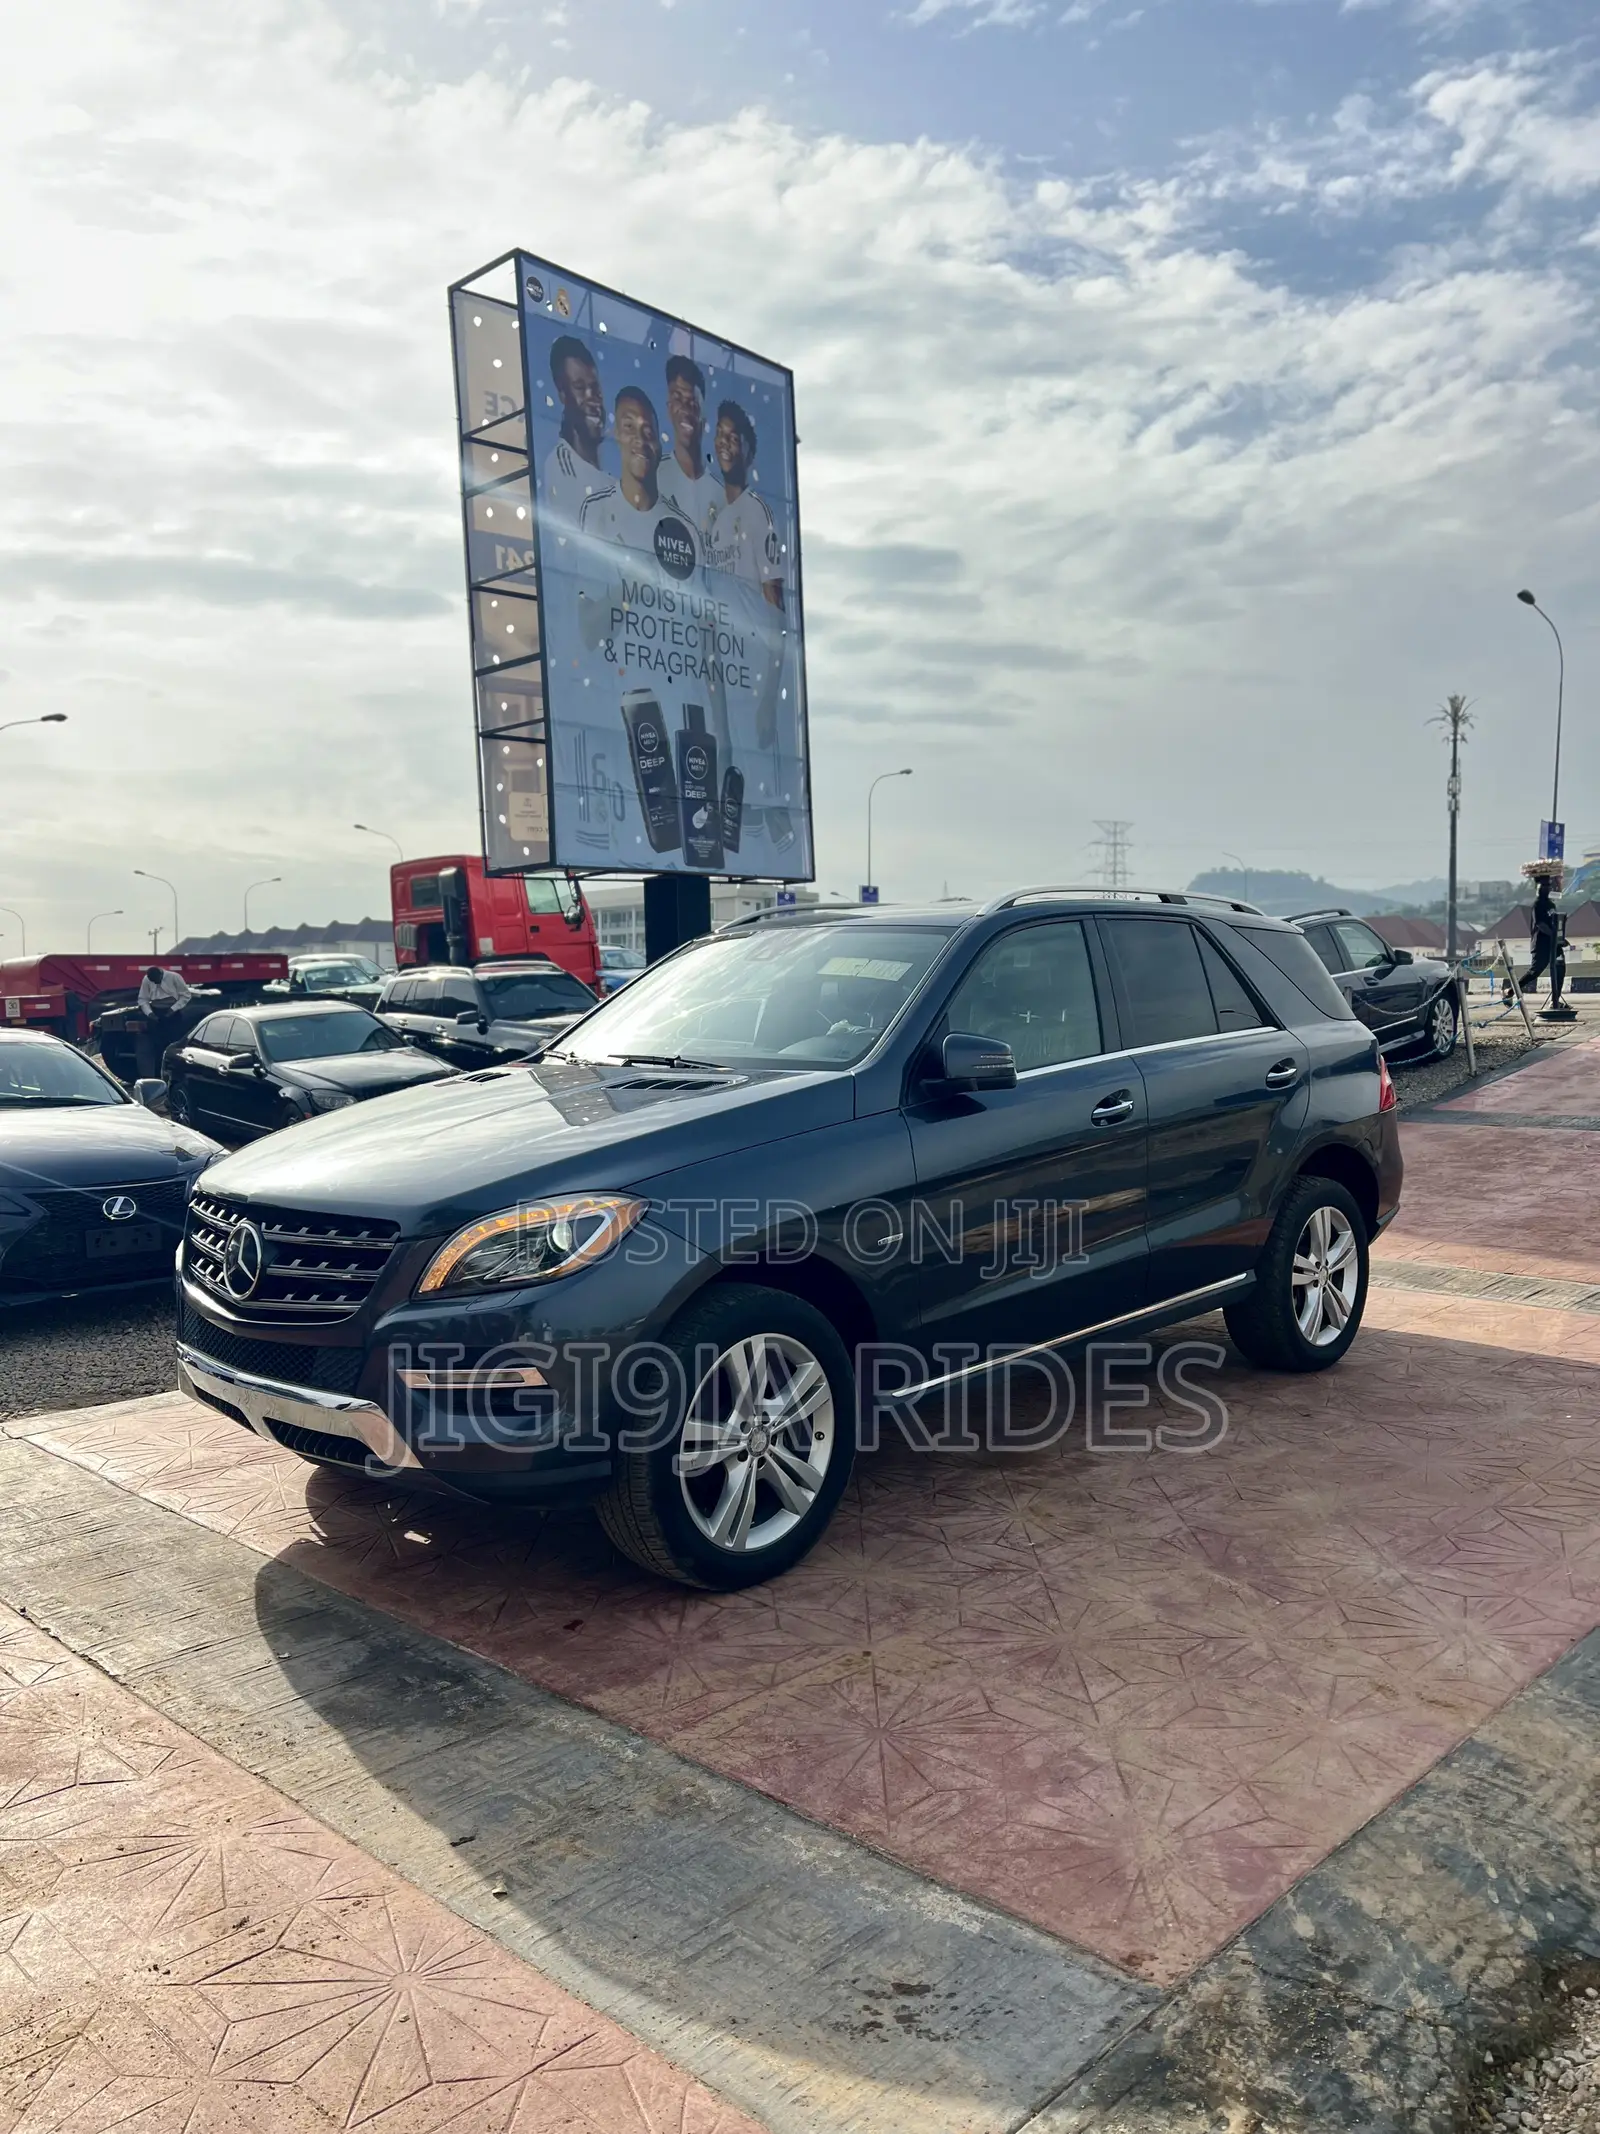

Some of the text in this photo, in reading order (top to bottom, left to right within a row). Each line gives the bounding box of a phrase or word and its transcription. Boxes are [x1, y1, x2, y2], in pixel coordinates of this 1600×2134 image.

[658, 535, 692, 555] NIVEA
[663, 550, 688, 567] MEN
[622, 579, 734, 631] MOISTURE,
[610, 607, 744, 659] PROTECTION
[604, 638, 751, 689] & FRAGRANCE
[640, 757, 665, 769] DEEP
[689, 757, 706, 766] NIVEA
[685, 790, 707, 799] DEEP
